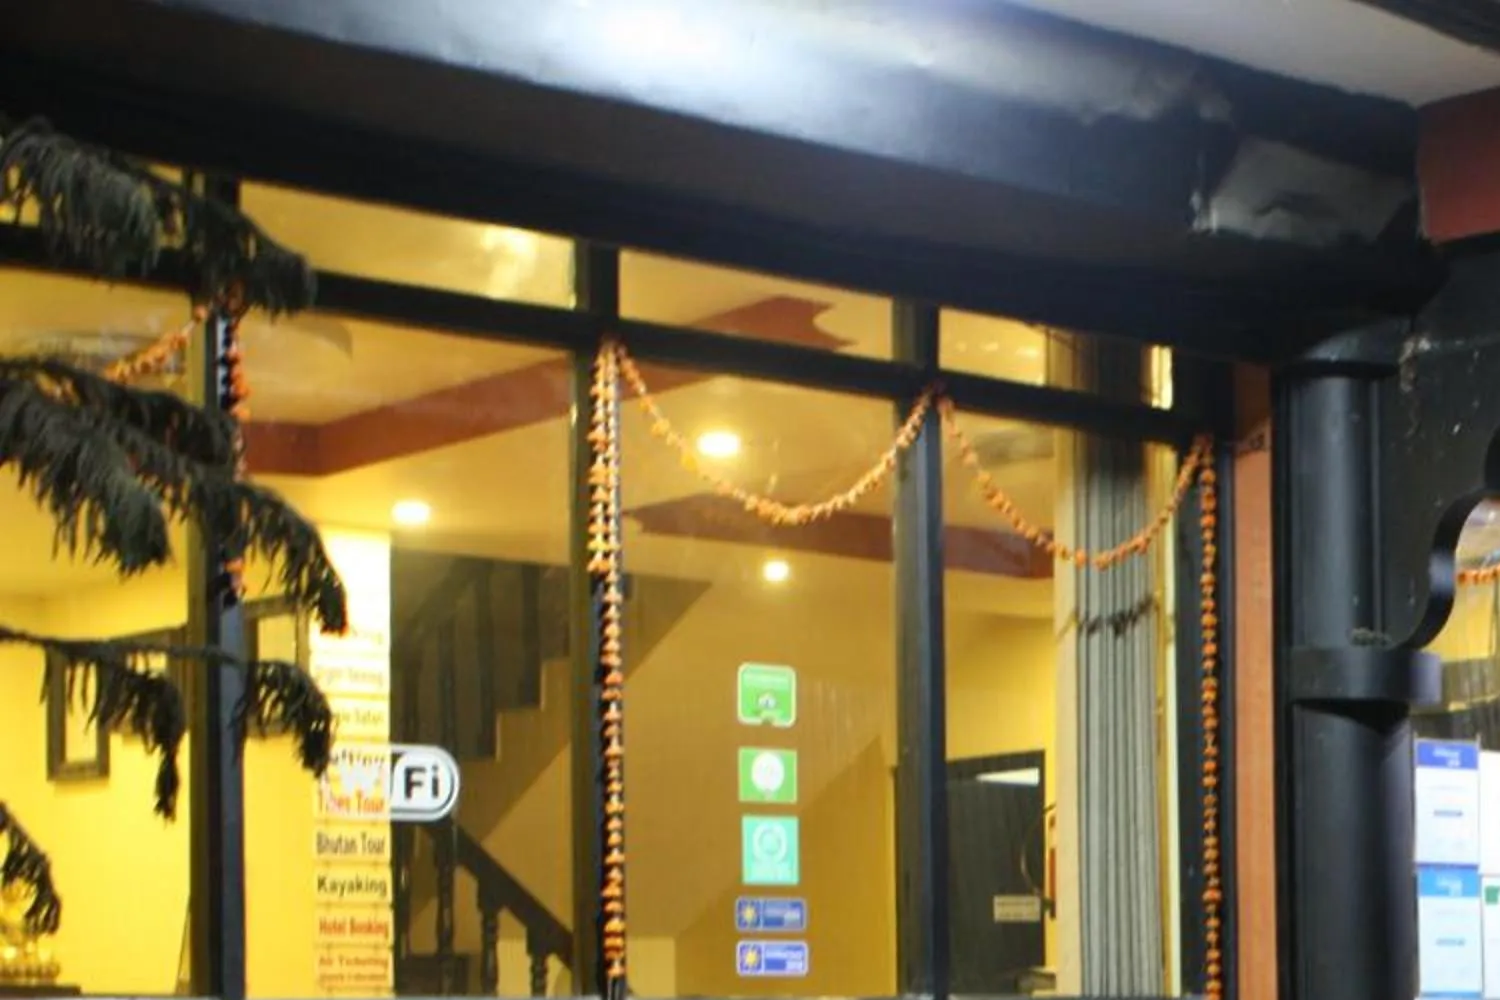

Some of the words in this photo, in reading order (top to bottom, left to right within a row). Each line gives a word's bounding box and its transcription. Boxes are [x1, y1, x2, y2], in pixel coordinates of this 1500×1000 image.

[404, 764, 441, 799] Fi
[316, 830, 358, 857] Bhutan
[360, 831, 386, 856] Tour
[317, 873, 388, 897] Kayaking
[318, 915, 347, 936] Hotel
[349, 915, 389, 941] Booking
